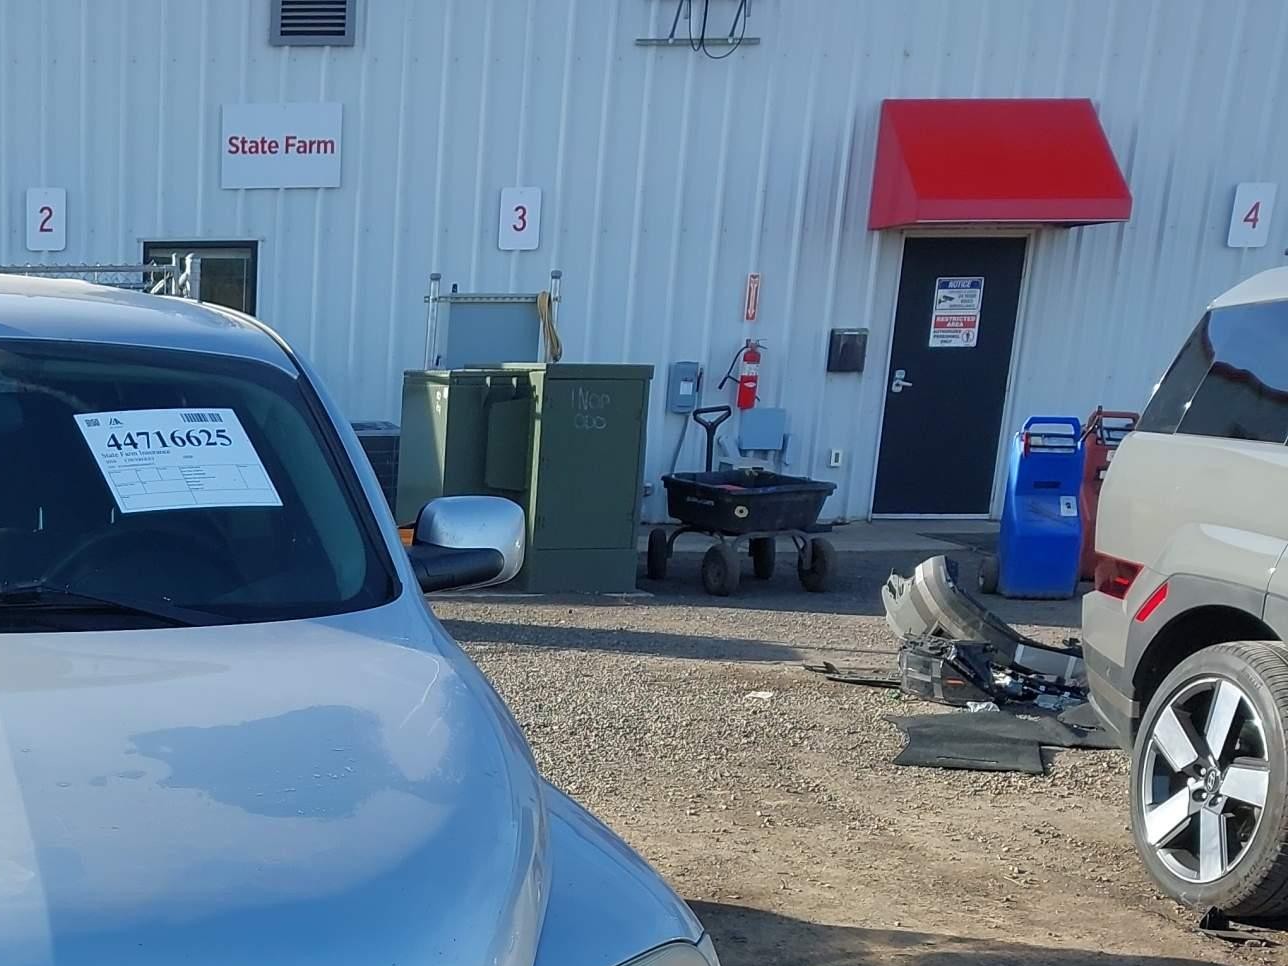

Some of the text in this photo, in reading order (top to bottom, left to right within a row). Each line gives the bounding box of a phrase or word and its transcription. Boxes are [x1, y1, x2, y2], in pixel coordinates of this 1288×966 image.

[227, 135, 335, 155] State Farm
[39, 206, 53, 232] 2
[512, 205, 527, 231] 3
[1243, 201, 1260, 229] 4
[948, 280, 972, 288] NOTICE
[107, 429, 232, 450] 44716625
